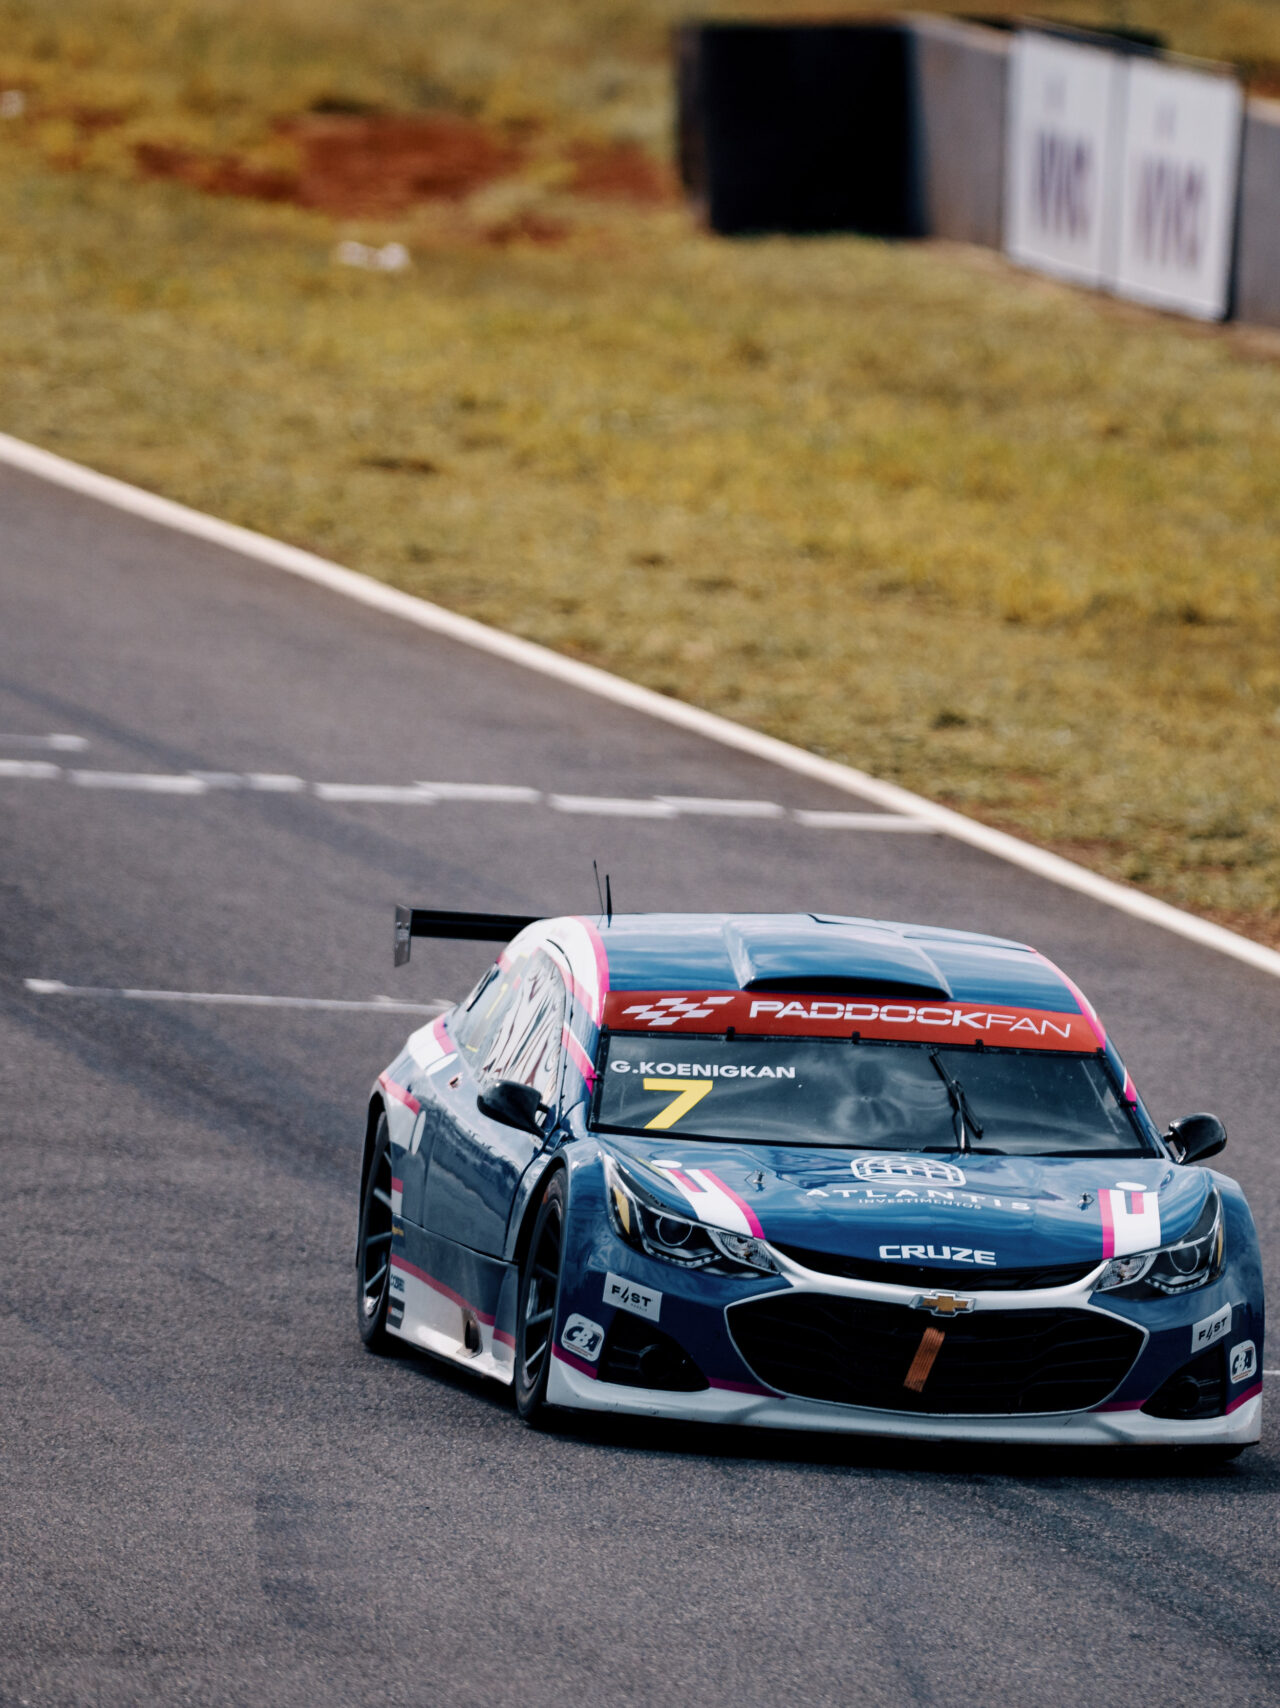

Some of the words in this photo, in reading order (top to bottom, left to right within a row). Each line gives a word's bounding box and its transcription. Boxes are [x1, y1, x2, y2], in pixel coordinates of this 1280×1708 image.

[609, 1059, 797, 1080] G.KOENIGKAN
[642, 1077, 714, 1130] 7
[805, 1188, 1032, 1212] ATLANTIS
[858, 1197, 983, 1211] INVESTIMENTOS
[878, 1244, 998, 1267] CRUZE
